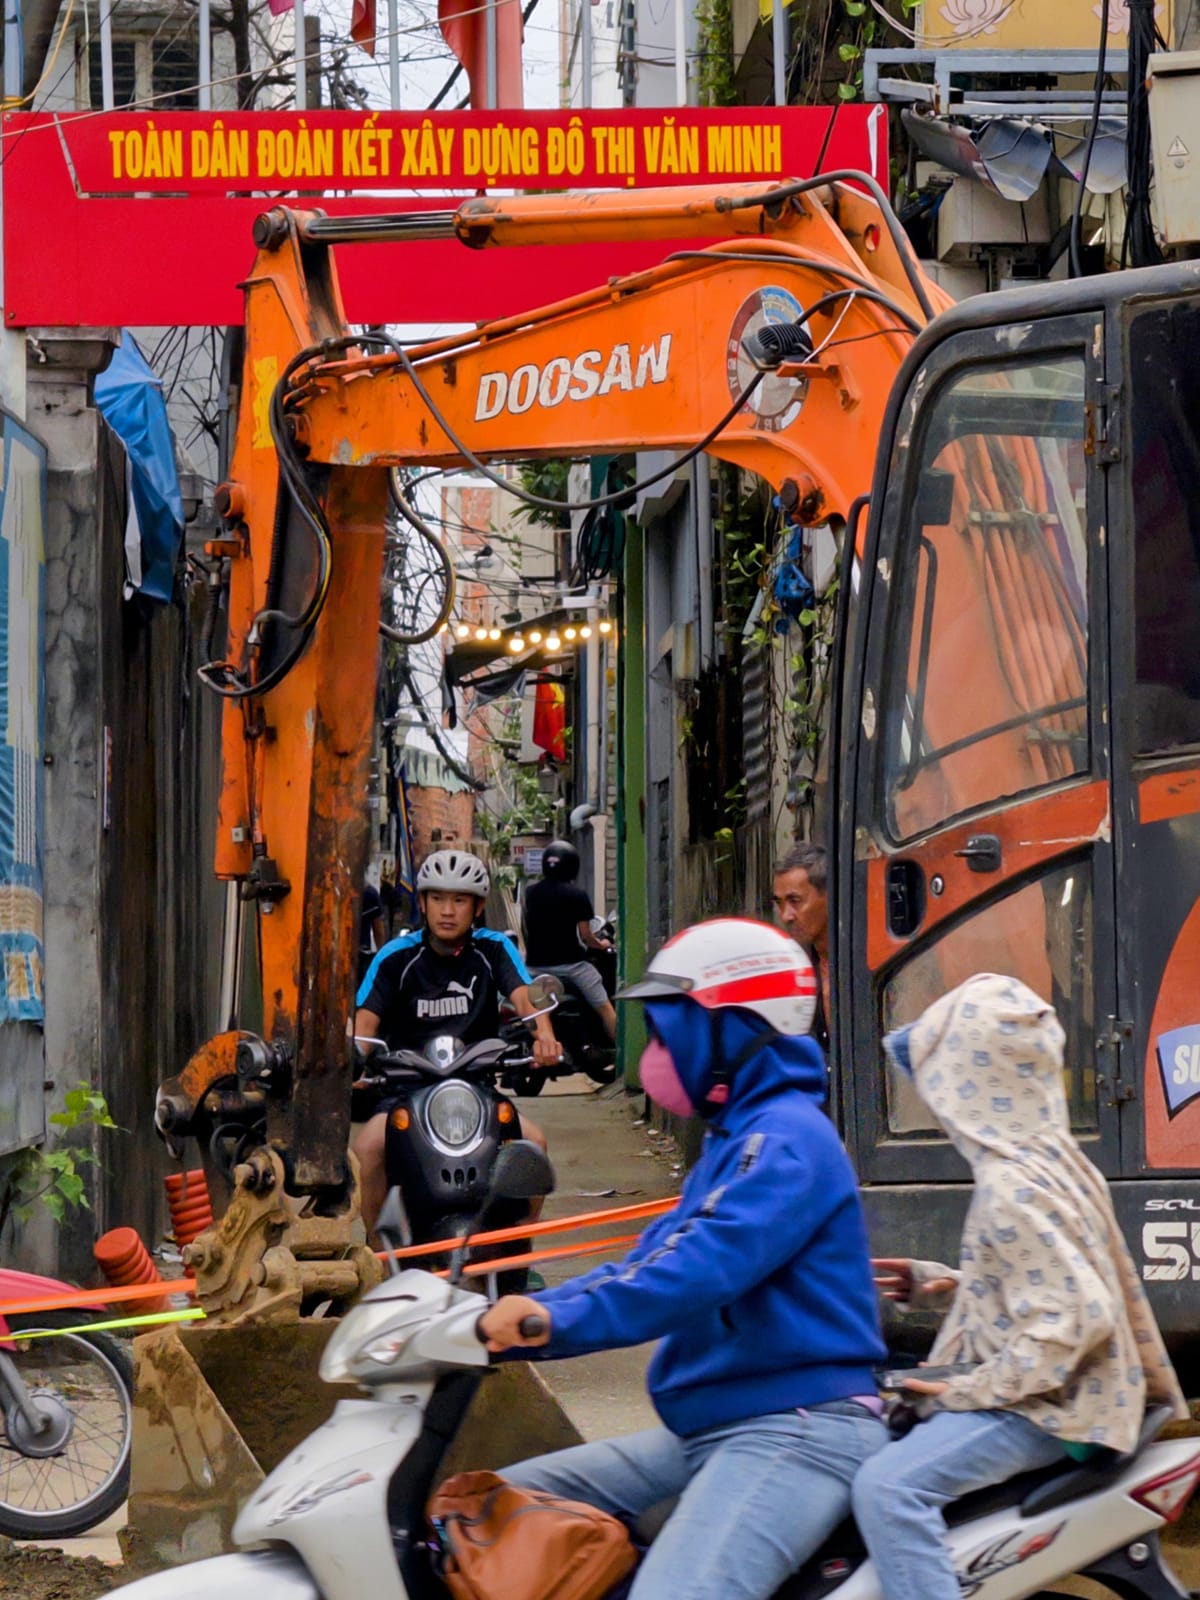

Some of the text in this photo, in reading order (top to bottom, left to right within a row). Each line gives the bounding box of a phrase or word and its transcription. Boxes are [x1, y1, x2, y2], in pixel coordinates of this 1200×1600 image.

[109, 111, 781, 186] TOÀN DÂN ĐOÀN KẾT XÂY DỰNG ĐÔ THỊ VĂN MINH
[474, 333, 672, 423] DOOSAN
[416, 995, 469, 1018] PUMA
